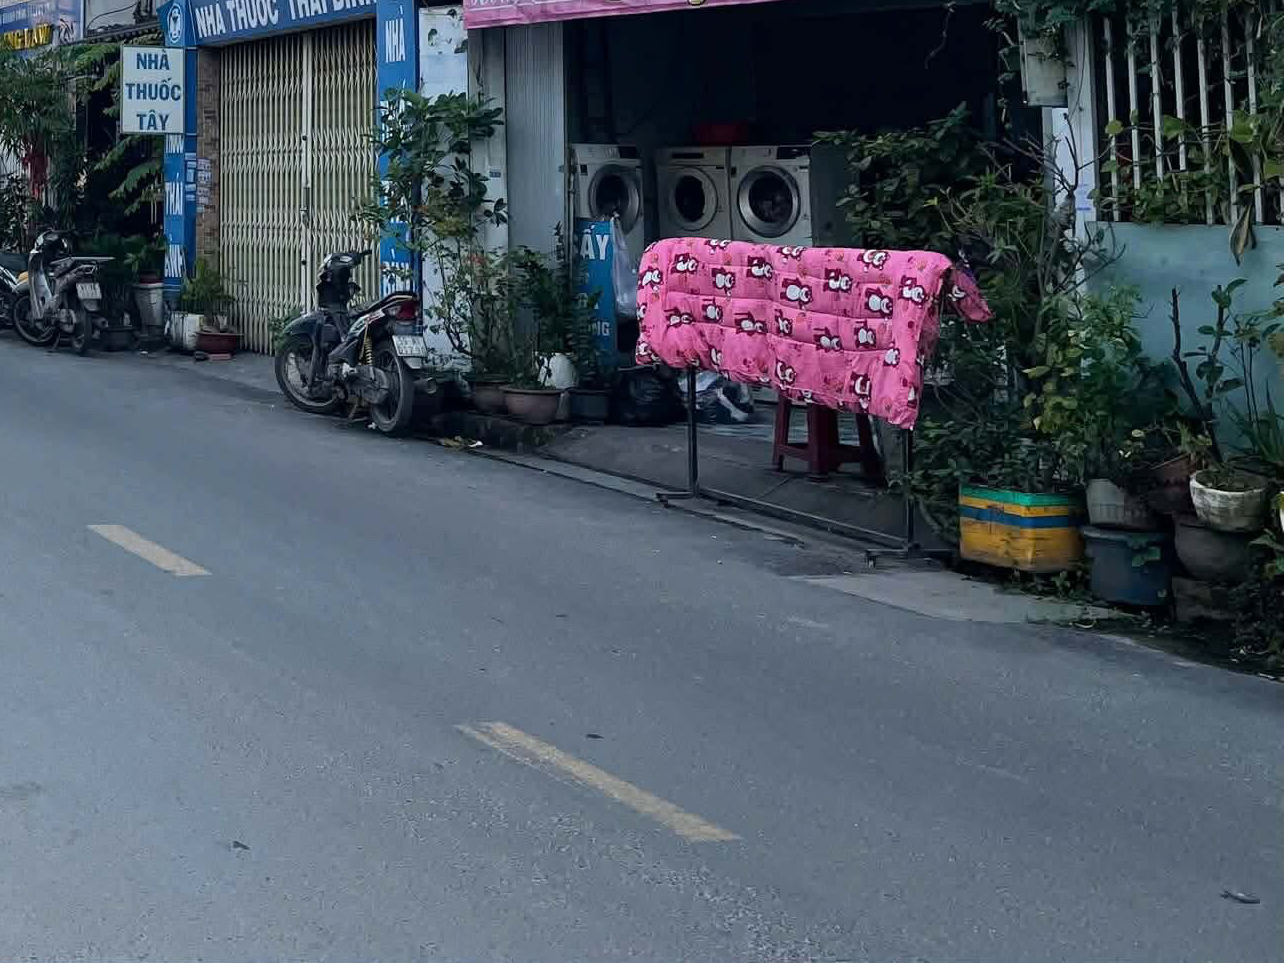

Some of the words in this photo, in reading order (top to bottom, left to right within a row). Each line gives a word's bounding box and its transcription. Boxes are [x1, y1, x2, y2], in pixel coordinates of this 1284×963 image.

[385, 5, 406, 63] NHÀ
[136, 49, 171, 71] NHÀ
[125, 78, 181, 101] THUỐC
[137, 111, 170, 131] TÂY
[580, 224, 609, 260] ẤY
